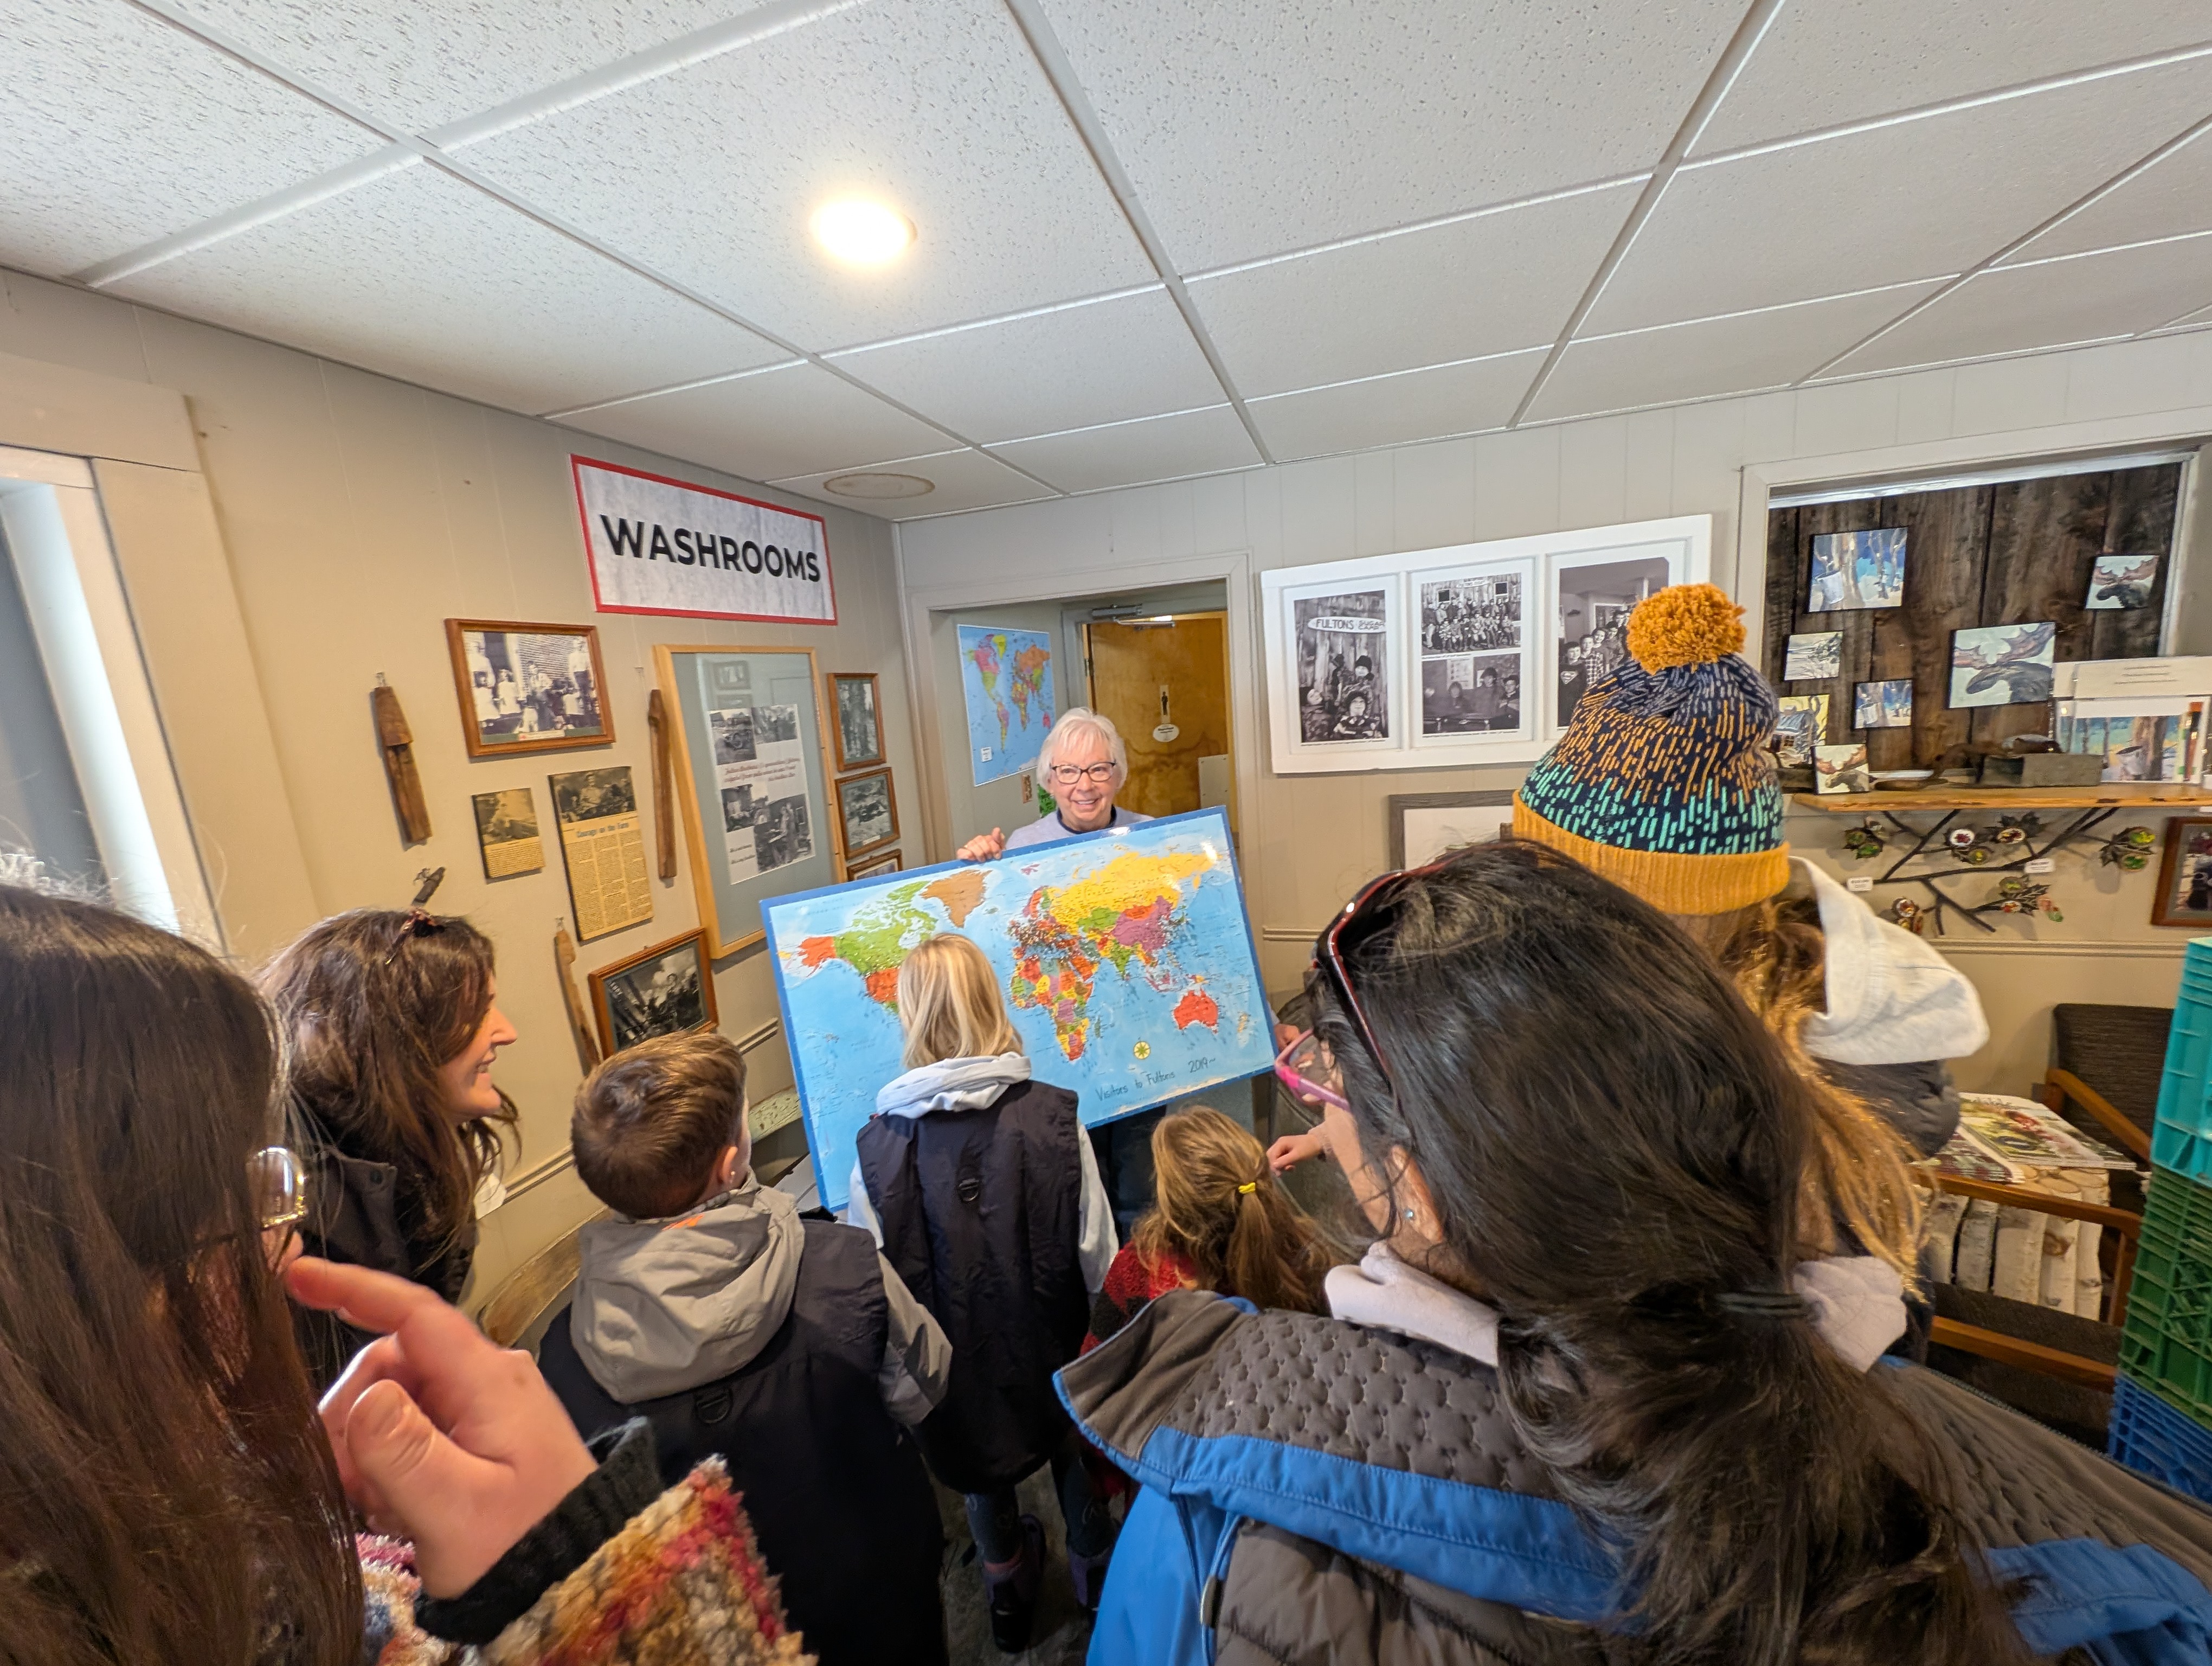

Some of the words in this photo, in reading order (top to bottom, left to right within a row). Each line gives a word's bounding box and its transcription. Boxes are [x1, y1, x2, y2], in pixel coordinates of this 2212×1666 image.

[600, 514, 820, 582] WASHROOMS
[1316, 619, 1354, 630] FULTONS
[1095, 1085, 1129, 1101] Visitors
[1135, 1080, 1143, 1088] to
[1146, 1071, 1175, 1085] Fultons
